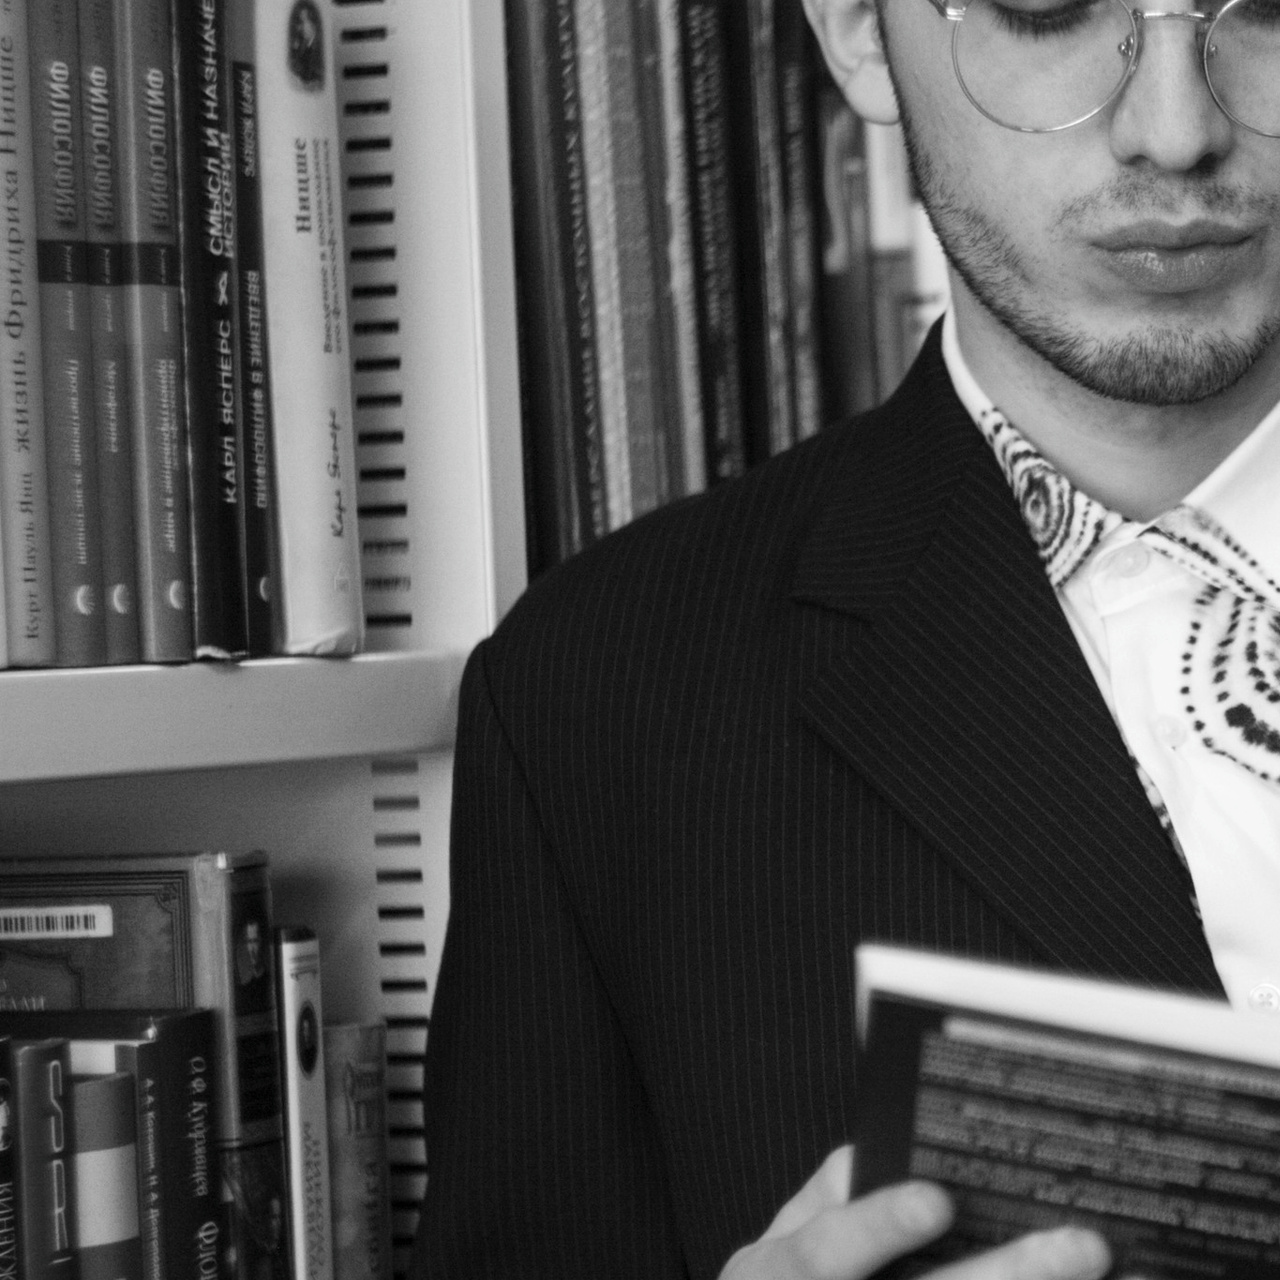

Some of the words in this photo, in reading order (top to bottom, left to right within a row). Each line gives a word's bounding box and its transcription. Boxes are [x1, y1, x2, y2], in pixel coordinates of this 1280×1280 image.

[0, 34, 20, 159] Ницше
[48, 60, 76, 225] ФИЛОСОФИЯ
[87, 65, 114, 229] ФИЛОСОФИЯ
[146, 67, 171, 229] ФИЛОСОФИЯ
[204, 128, 219, 147] И
[204, 157, 224, 256] СМЫСЛ
[219, 132, 234, 258] ИСТОРИИ
[292, 137, 312, 234] Ницше
[0, 168, 29, 341] Фридриха
[217, 318, 235, 425] ЯСПЕРС
[246, 270, 262, 373] ВВЕДЕНИЕ
[9, 350, 34, 453] жизнь
[103, 359, 120, 454] Метафизика
[251, 388, 269, 509] ФИЛОСОФИЮ
[218, 434, 238, 504] КАРЛ
[329, 489, 347, 539] Карл
[20, 521, 40, 584] Пауль
[161, 511, 176, 554] мире
[21, 589, 43, 639] Курт
[186, 1100, 213, 1198] Кудрявцев
[363, 1160, 380, 1272] contra
